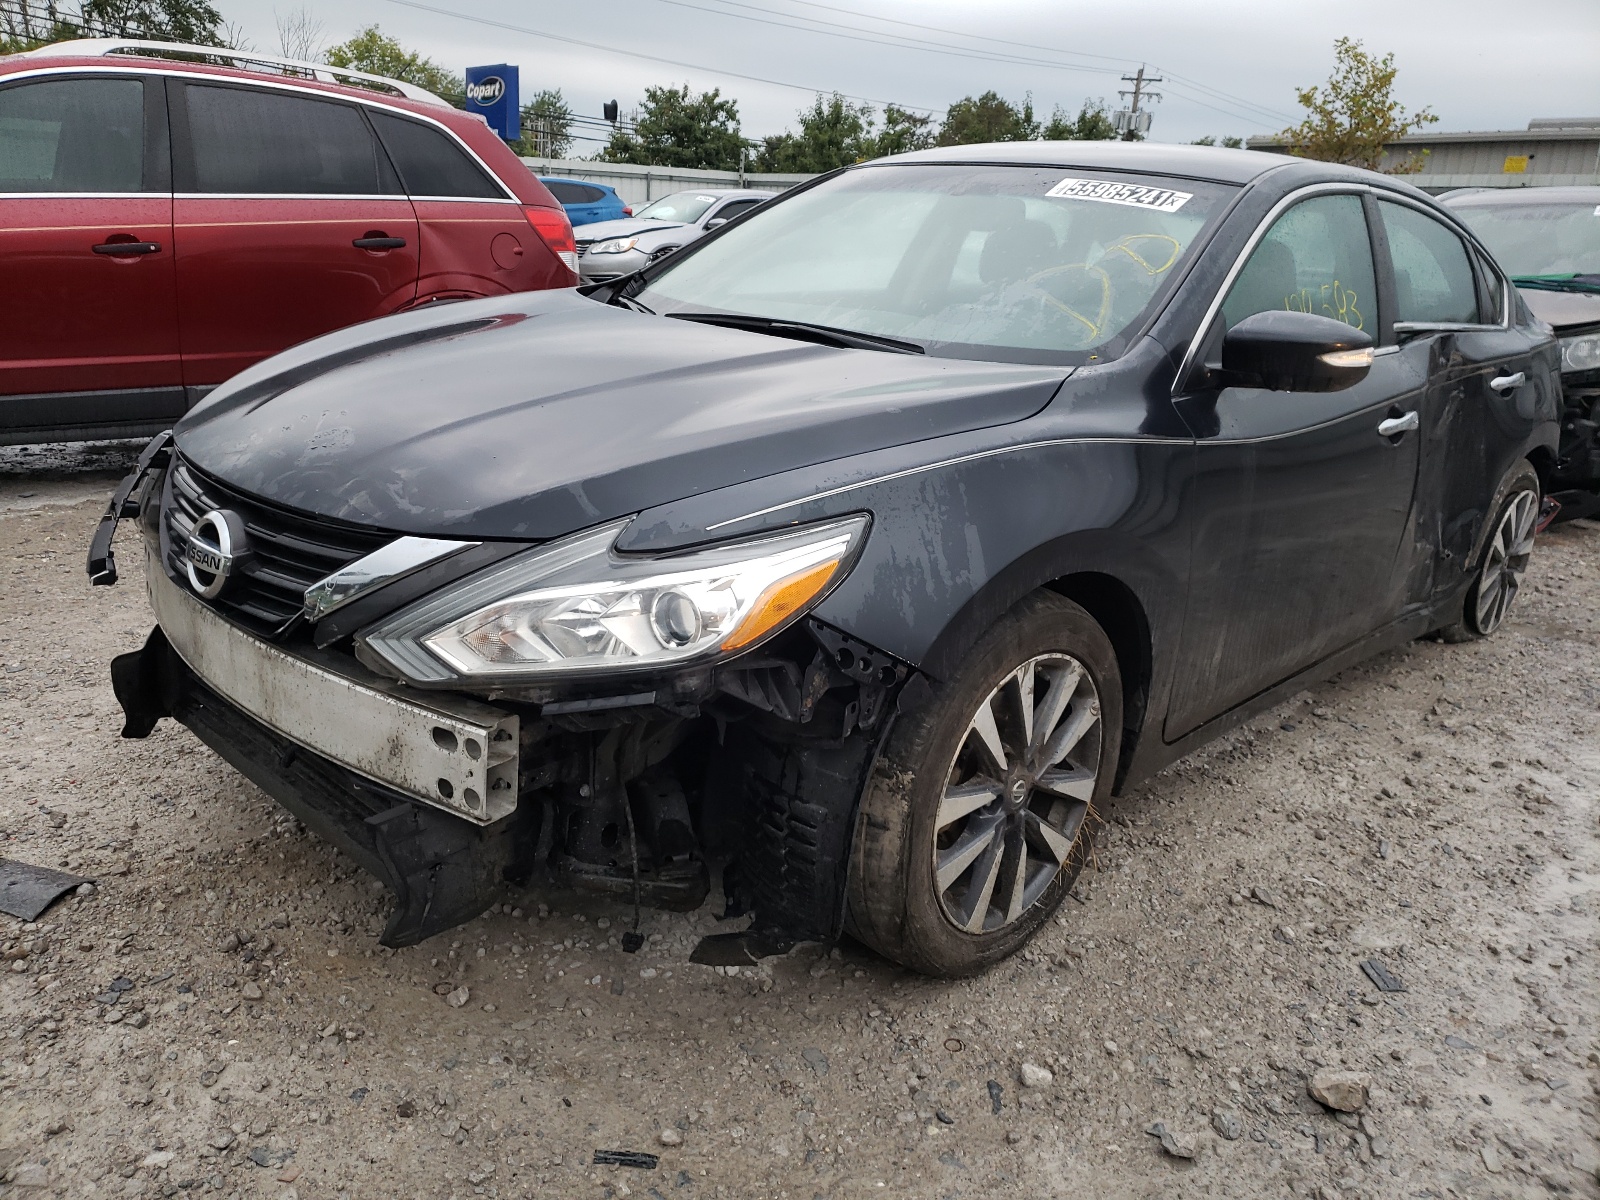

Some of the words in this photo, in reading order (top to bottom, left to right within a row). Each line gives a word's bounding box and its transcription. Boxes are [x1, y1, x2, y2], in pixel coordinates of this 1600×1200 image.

[467, 80, 500, 100] Copart
[1064, 179, 1172, 208] 55985241
[188, 544, 221, 571] SSAN
